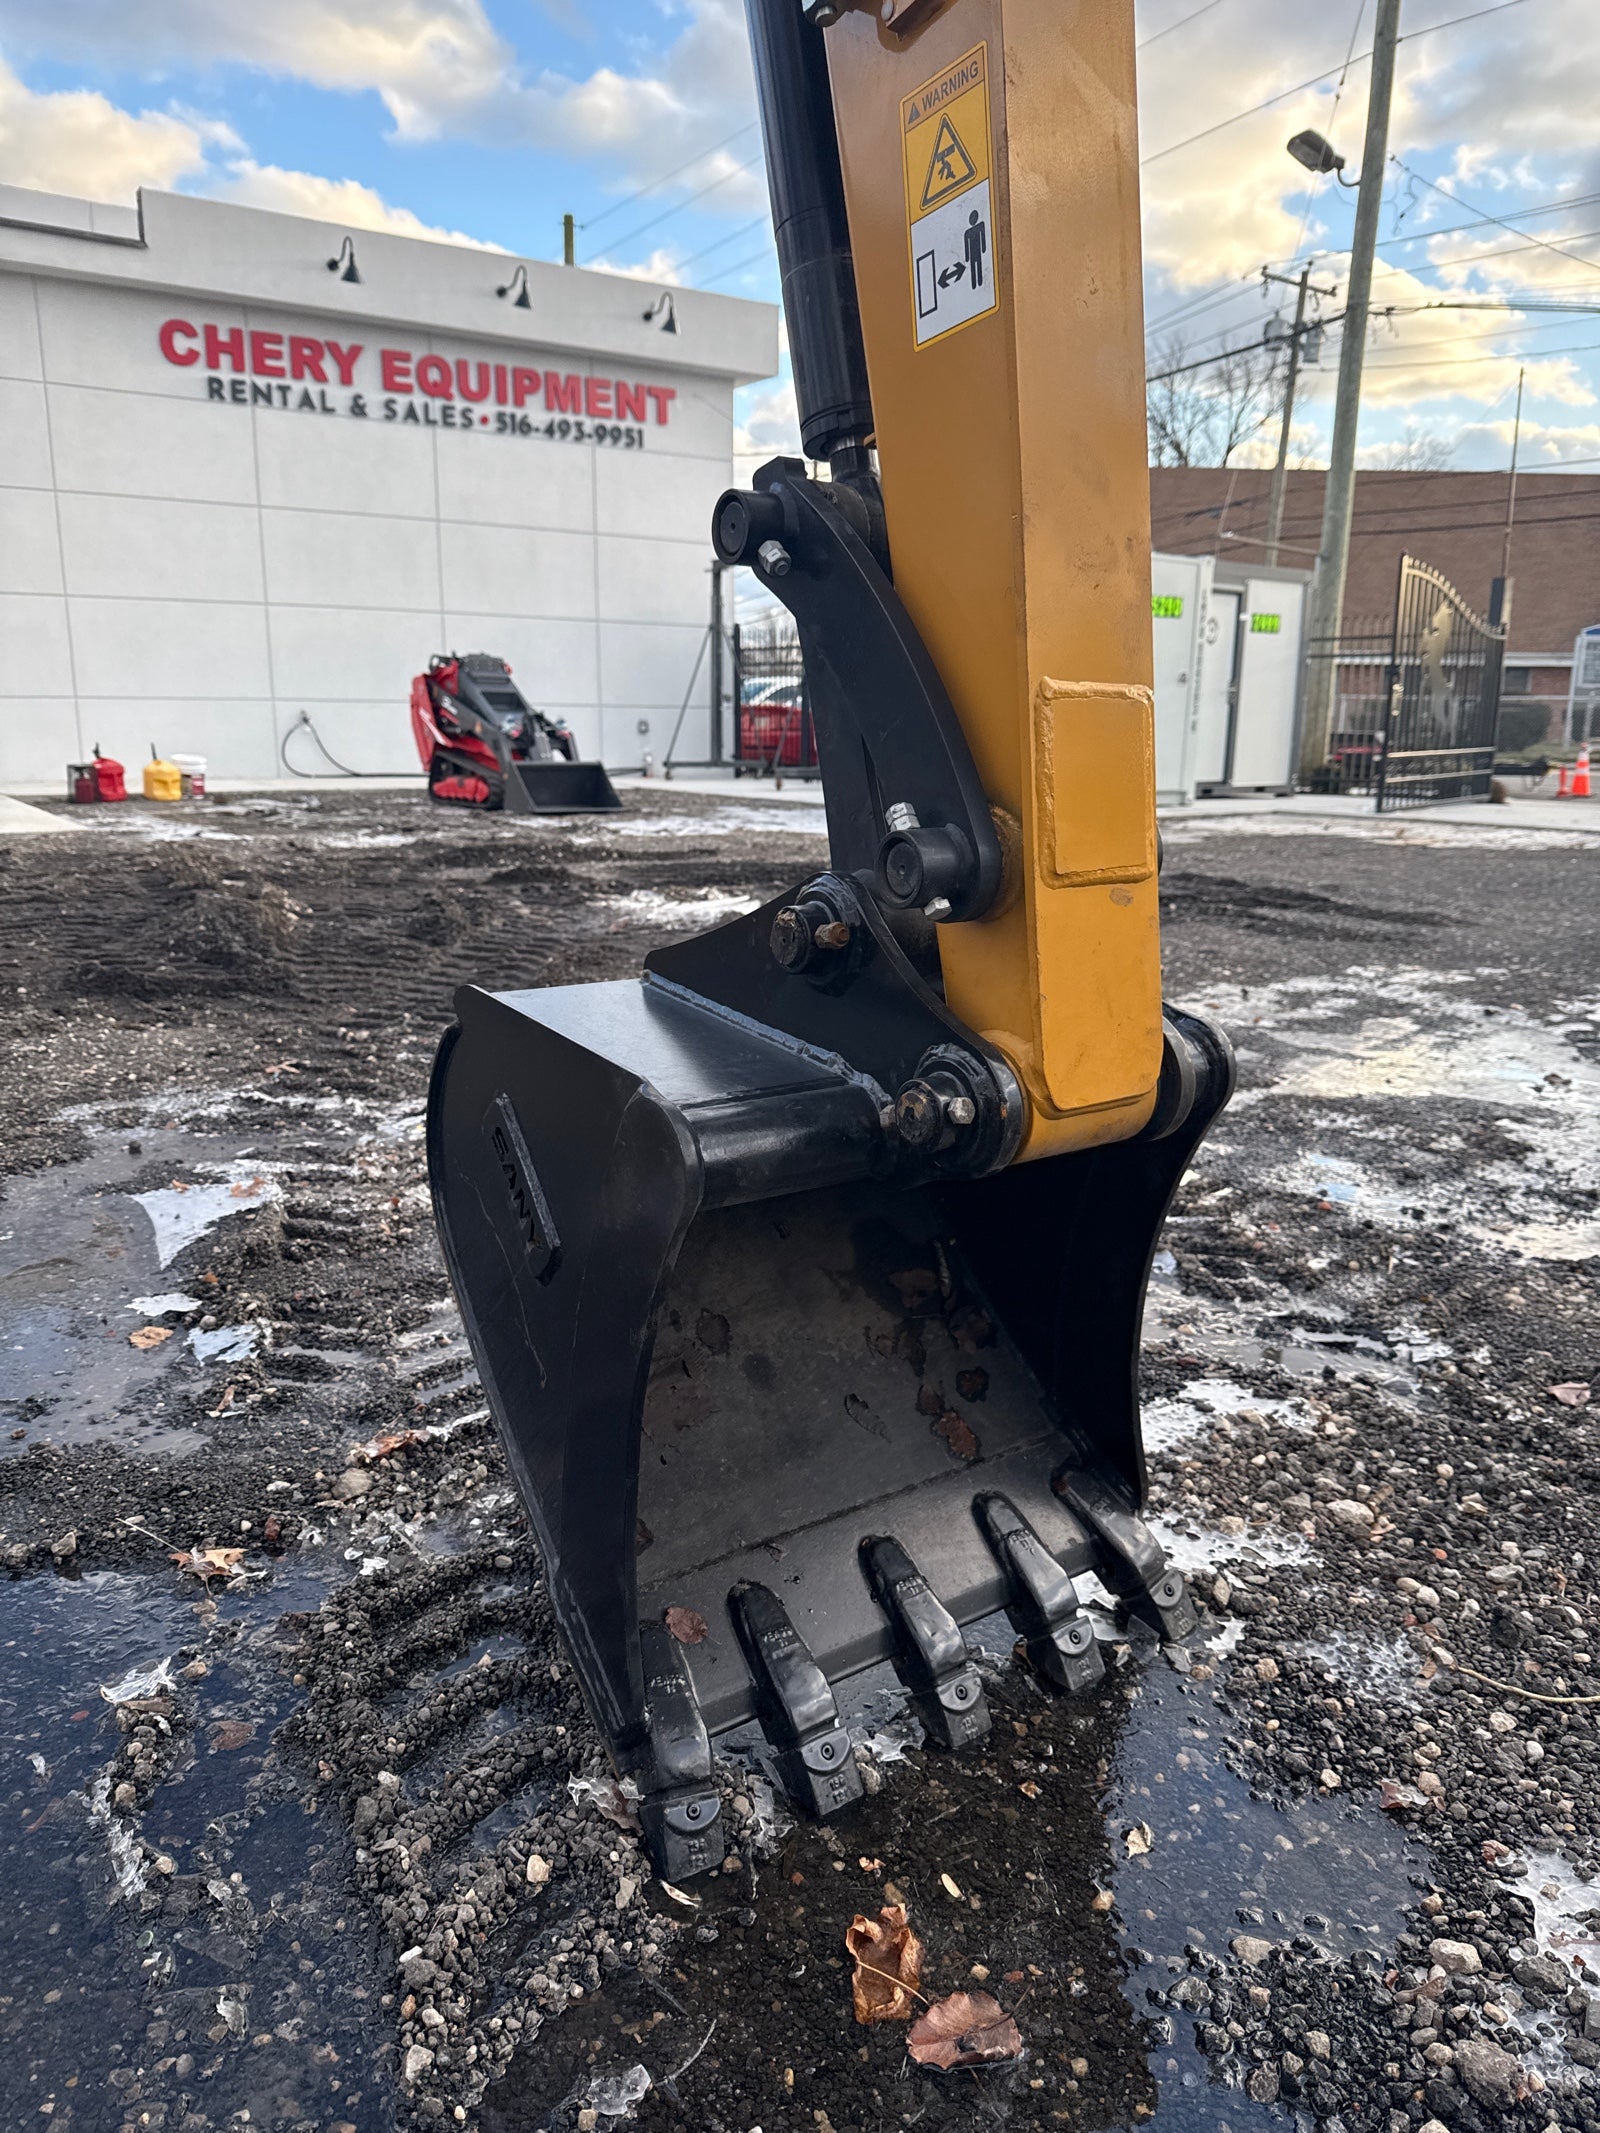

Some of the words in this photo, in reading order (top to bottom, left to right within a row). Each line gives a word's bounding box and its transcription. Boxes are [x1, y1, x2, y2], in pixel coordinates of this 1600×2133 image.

[921, 60, 980, 113] WARNING
[159, 319, 363, 385] CHERY
[381, 349, 676, 425] EQUIPMENT
[207, 376, 336, 414] RENTAL
[349, 394, 368, 418] &
[384, 398, 474, 429] SALES
[496, 411, 644, 448] 516-493-9951
